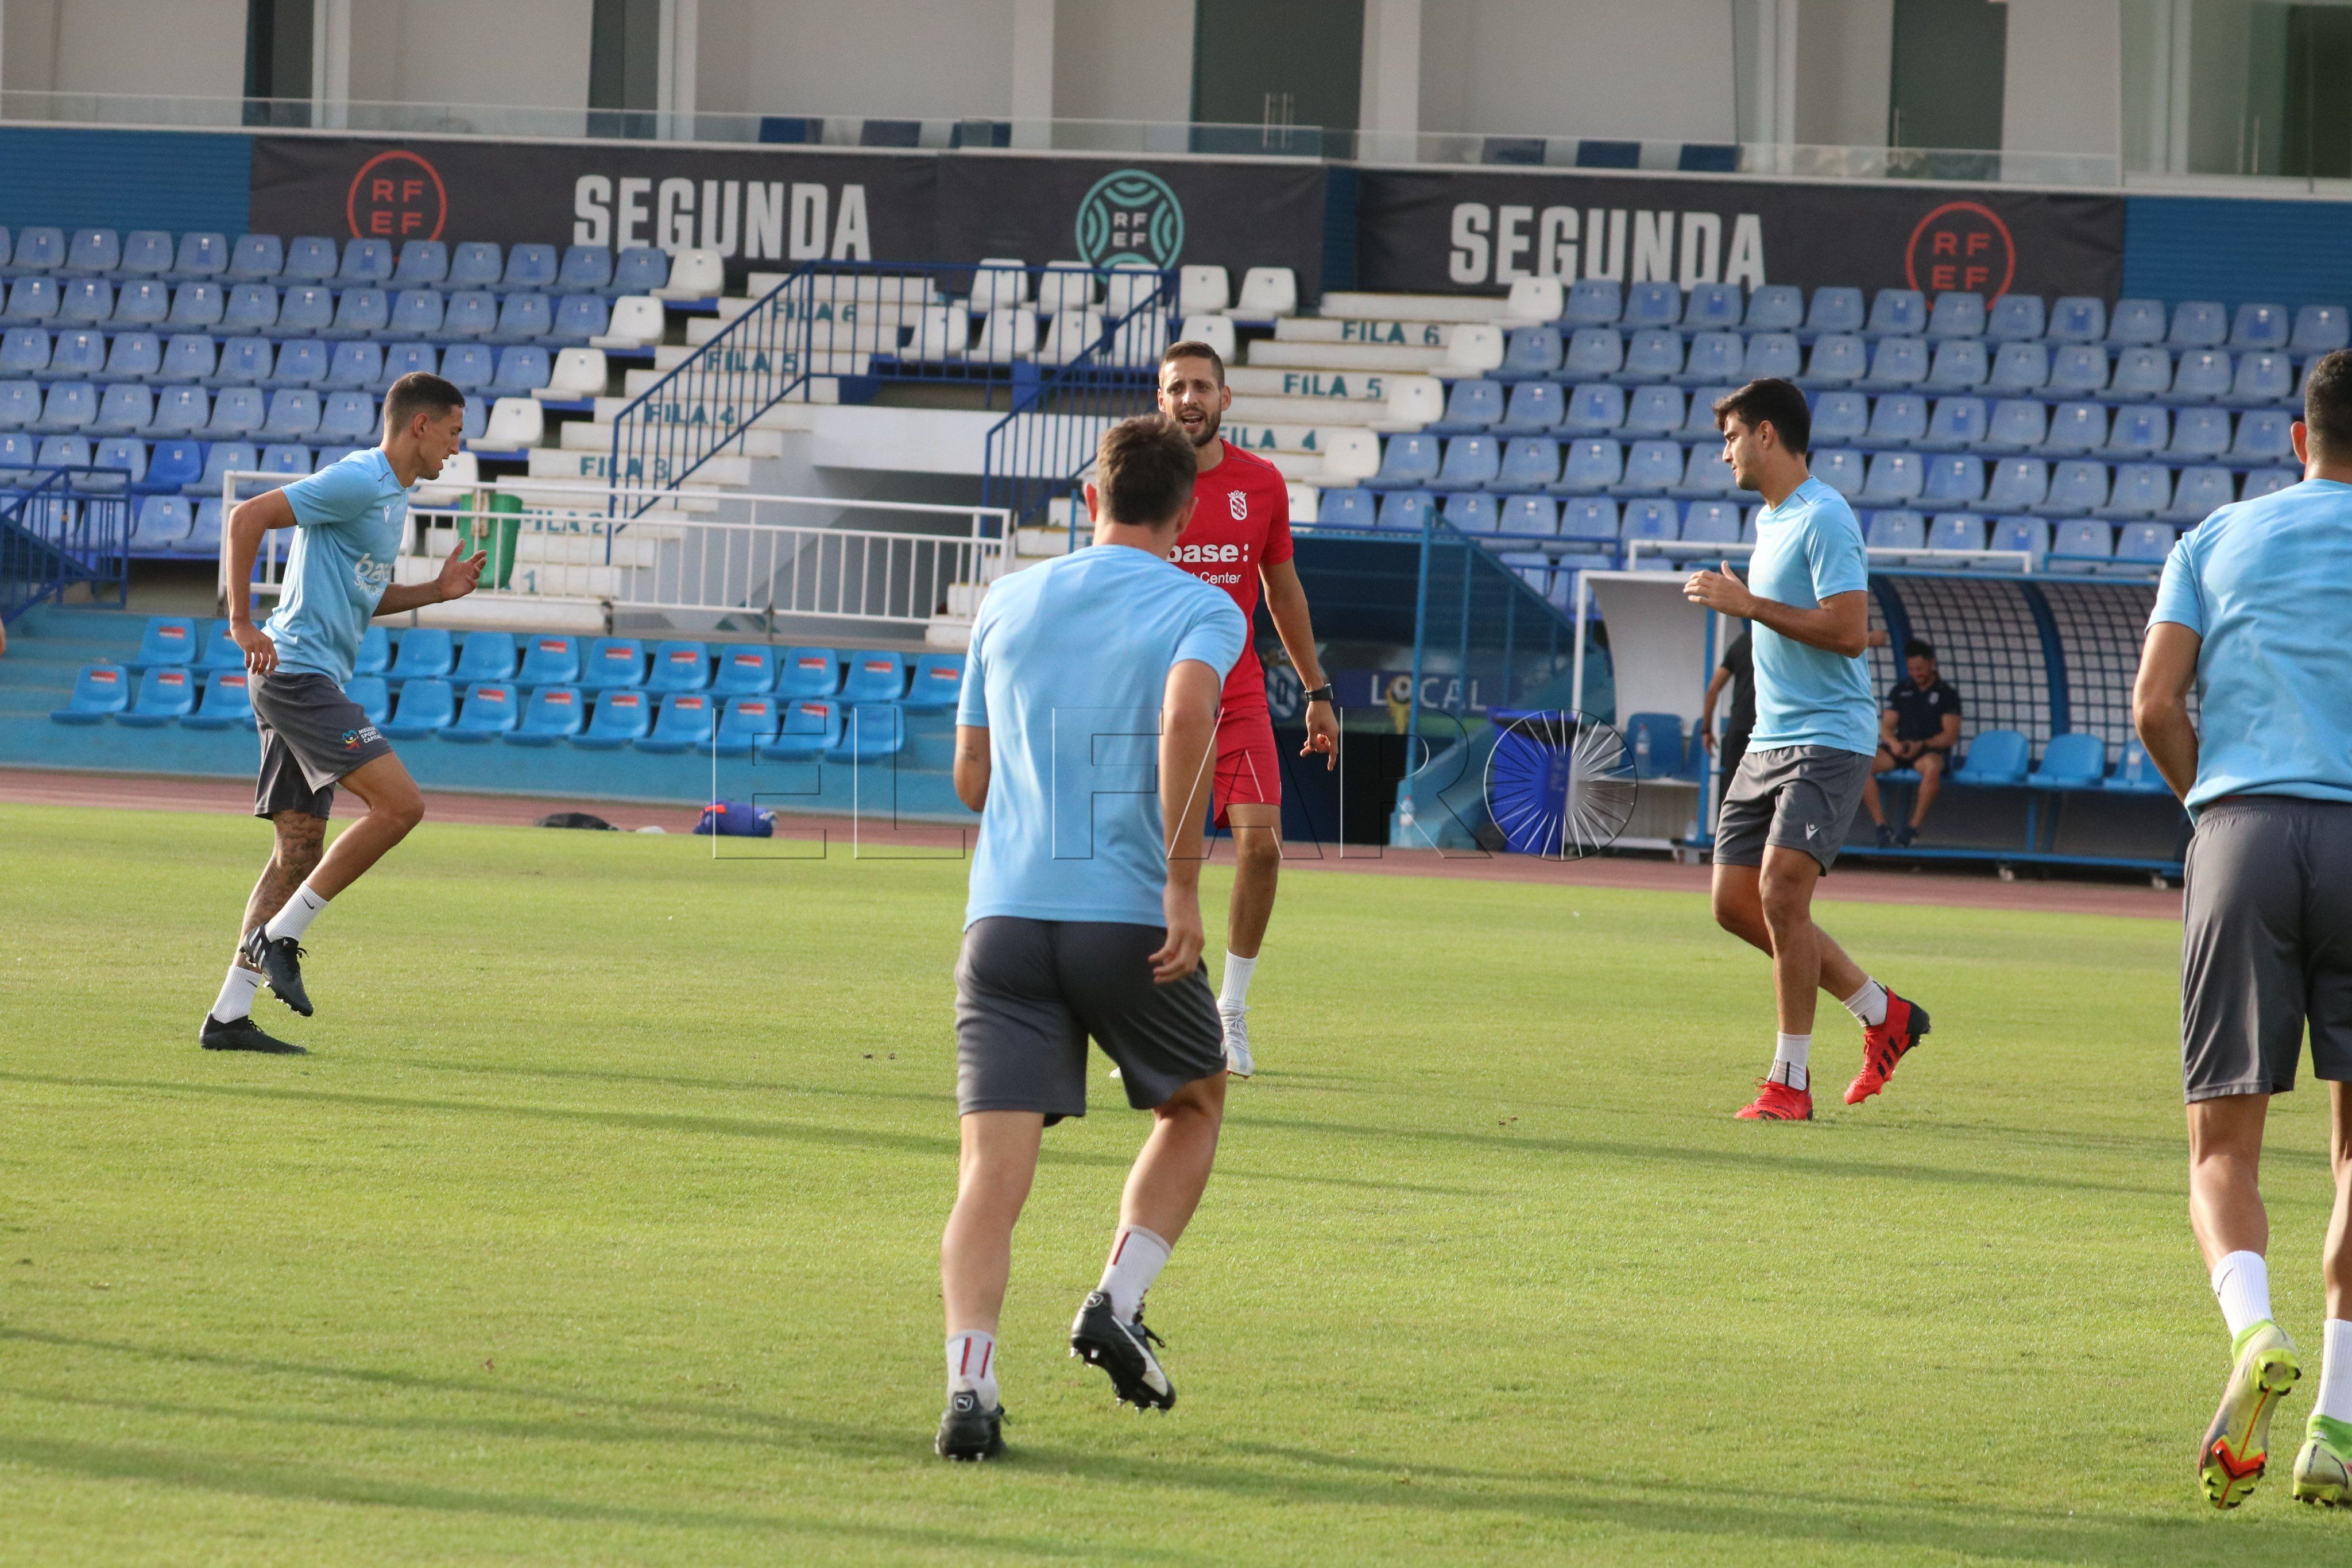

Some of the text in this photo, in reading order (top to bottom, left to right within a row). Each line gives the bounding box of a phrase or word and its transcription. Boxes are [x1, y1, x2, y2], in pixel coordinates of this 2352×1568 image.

[574, 174, 871, 261] SEGUNDA
[1449, 202, 1766, 293] SEGUNDA
[1341, 322, 1440, 345] FILA 6
[1283, 373, 1382, 398] FILA 5
[644, 403, 708, 425] FILA
[1302, 429, 1317, 451] 4
[1200, 571, 1241, 584] Center
[1370, 674, 1488, 712] LOCAL
[361, 730, 377, 740] SPORT
